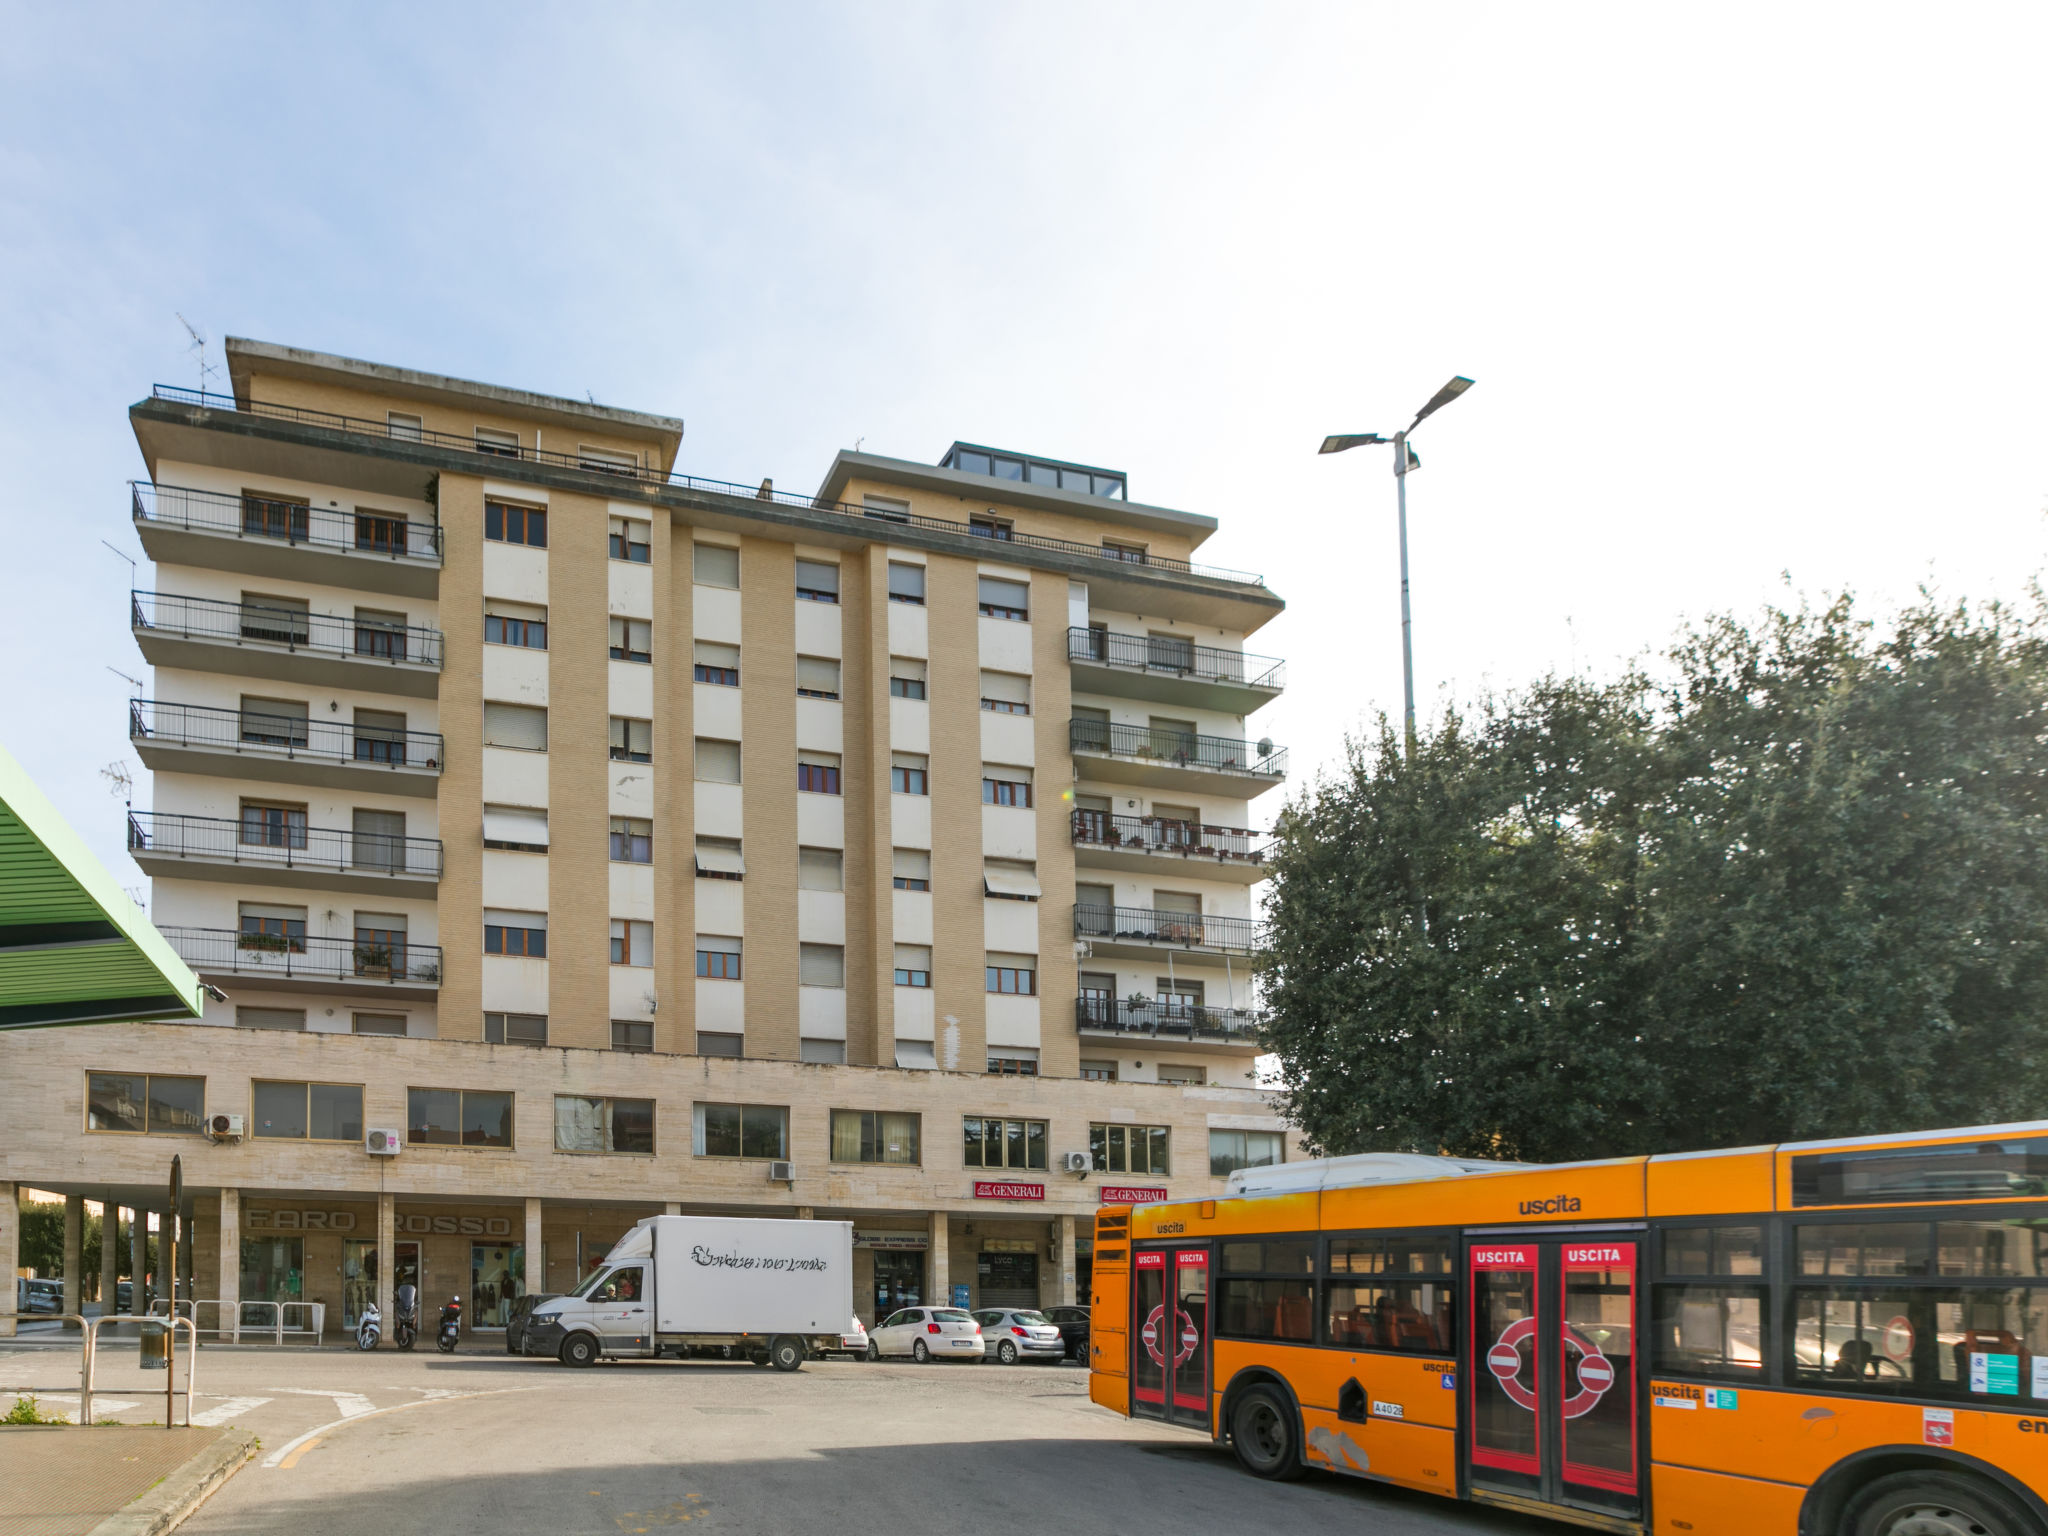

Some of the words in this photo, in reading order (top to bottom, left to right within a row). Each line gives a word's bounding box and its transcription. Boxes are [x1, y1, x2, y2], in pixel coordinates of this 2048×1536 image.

[992, 1184, 1042, 1198] GENERALI
[1117, 1189, 1165, 1201] GENERALI
[1519, 1194, 1581, 1215] uscita
[244, 1209, 356, 1231] FARO
[1157, 1222, 1184, 1234] uscita
[1138, 1255, 1160, 1264] USCITA
[1179, 1253, 1204, 1263] USCITA
[1477, 1252, 1525, 1263] USCITA
[1568, 1249, 1621, 1262] USCITA
[1423, 1362, 1456, 1374] uscita
[1652, 1384, 1702, 1400] uscita
